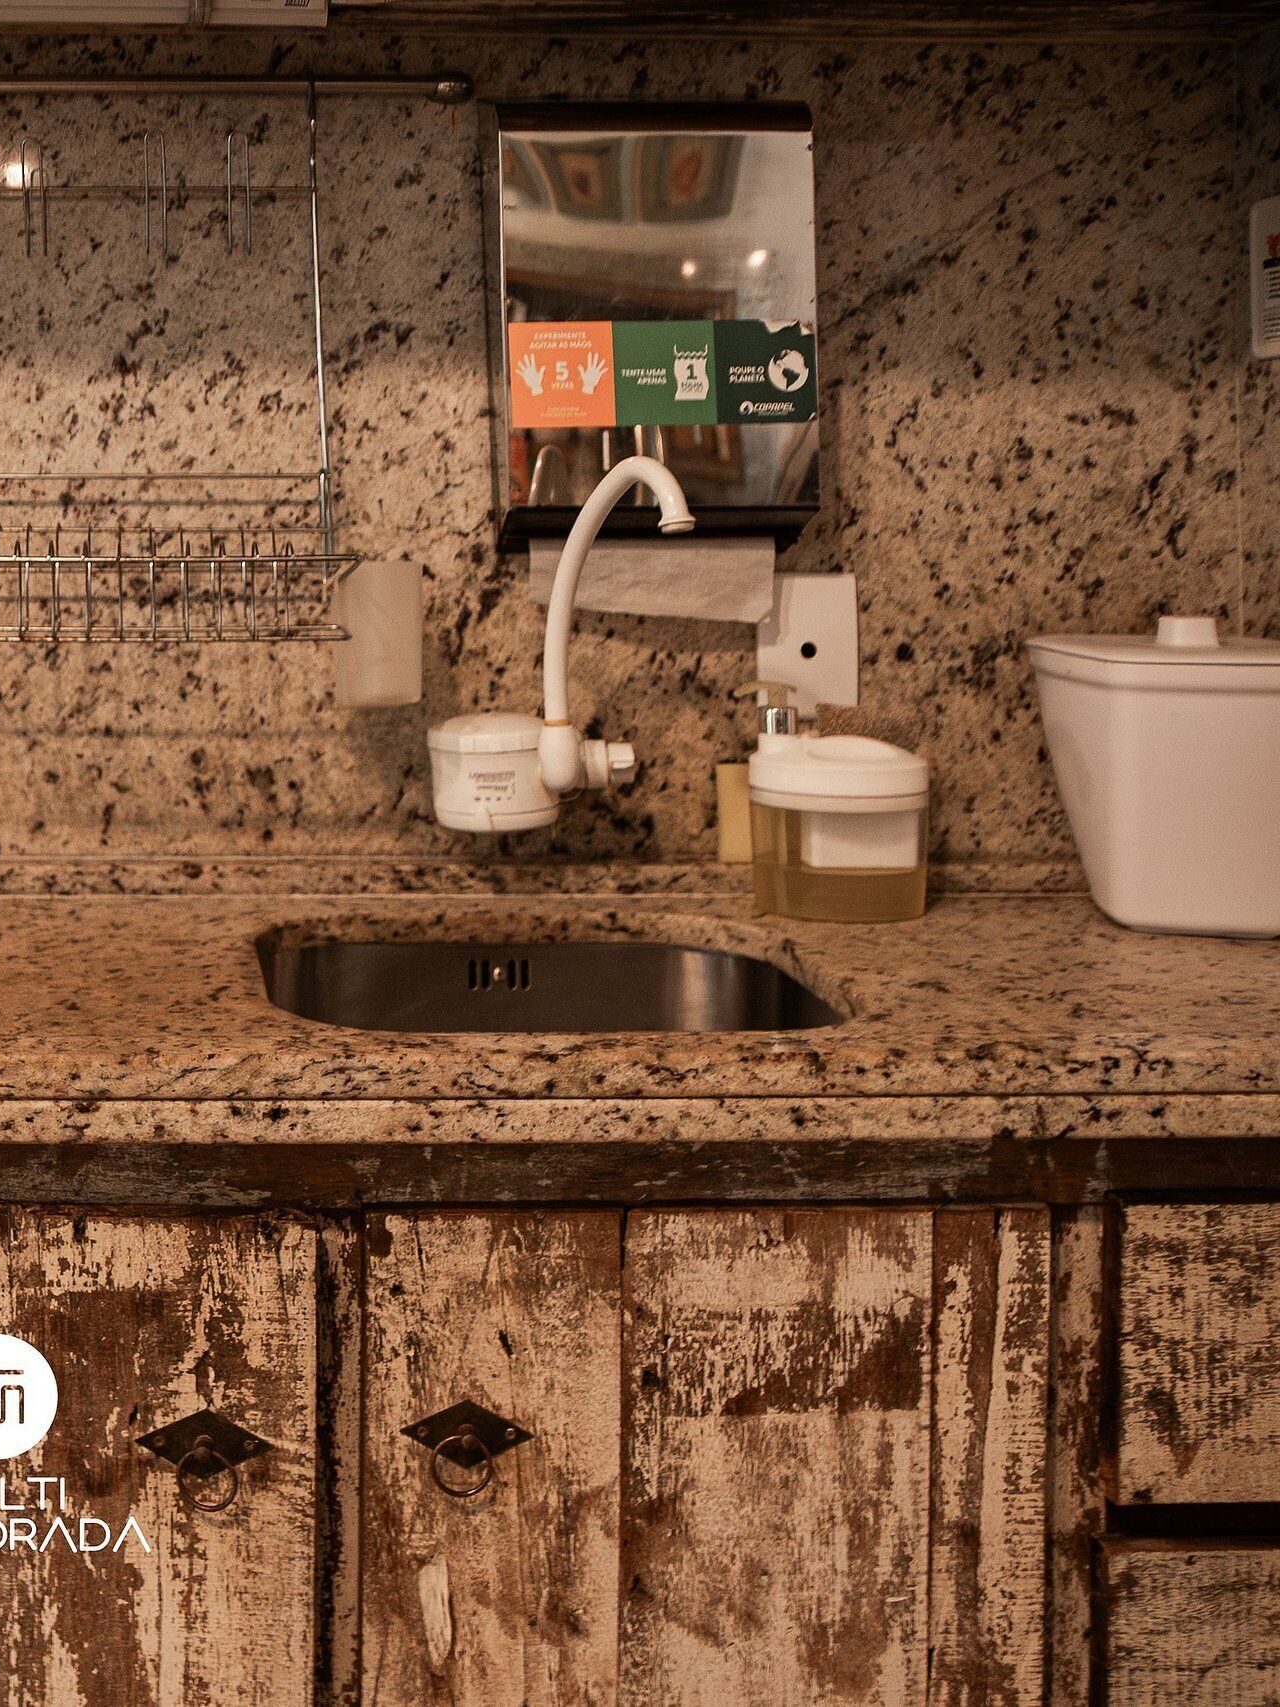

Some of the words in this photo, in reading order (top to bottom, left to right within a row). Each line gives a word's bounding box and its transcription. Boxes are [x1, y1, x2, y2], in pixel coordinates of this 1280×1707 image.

[555, 360, 569, 381] 5
[621, 368, 645, 377] TENTE
[686, 363, 698, 380] 1
[729, 366, 754, 375] POUPE
[637, 376, 667, 385] APENAS
[729, 374, 766, 383] PLANETA
[753, 401, 795, 412] COPAPEL
